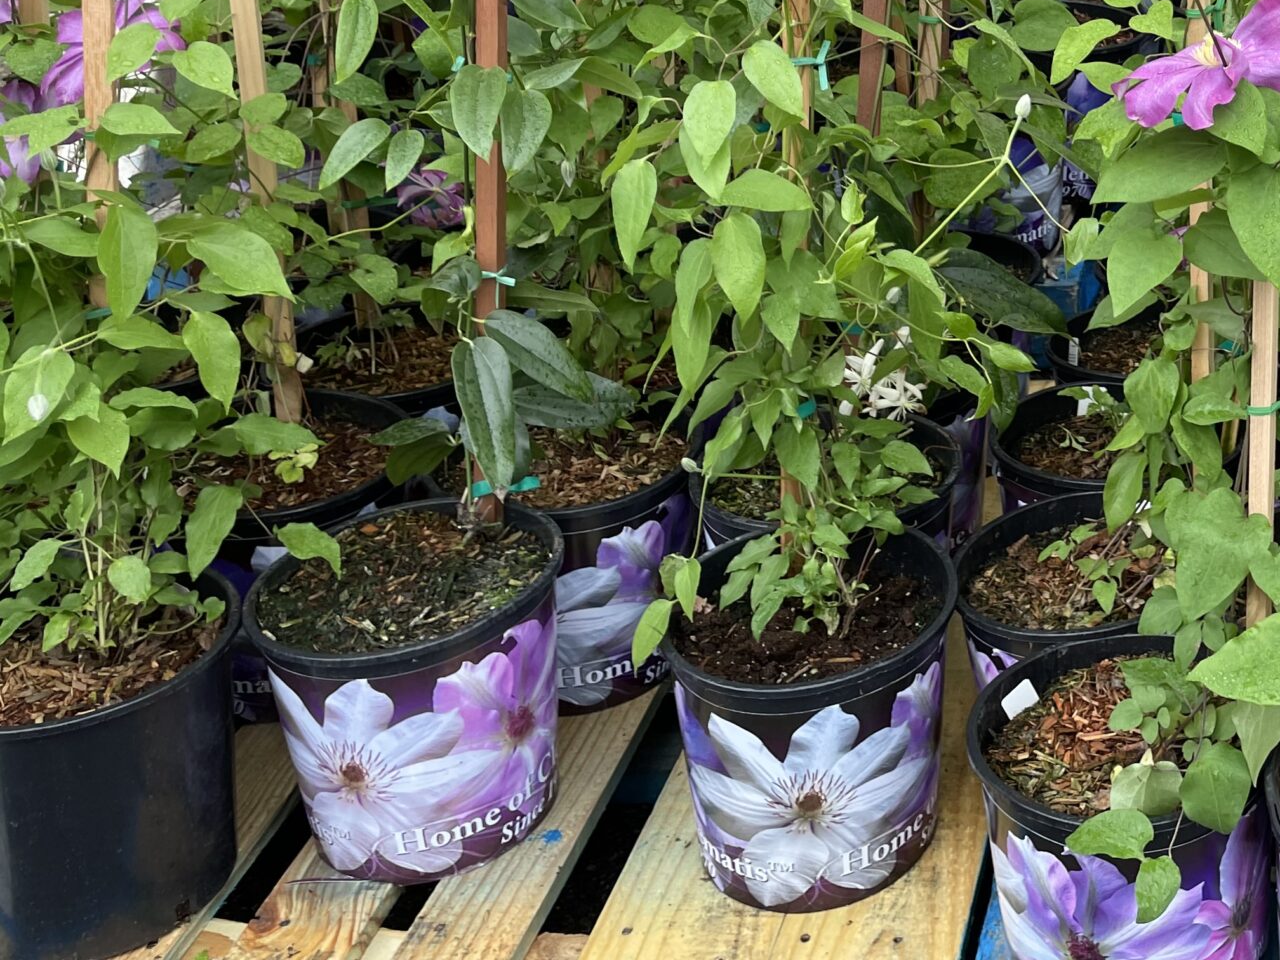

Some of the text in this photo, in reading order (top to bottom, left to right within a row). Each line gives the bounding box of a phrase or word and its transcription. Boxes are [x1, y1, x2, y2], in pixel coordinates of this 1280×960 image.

[556, 659, 634, 690] Hom
[393, 807, 502, 856] Home
[508, 770, 535, 812] of
[500, 802, 546, 845] Since
[840, 812, 924, 877] Home
